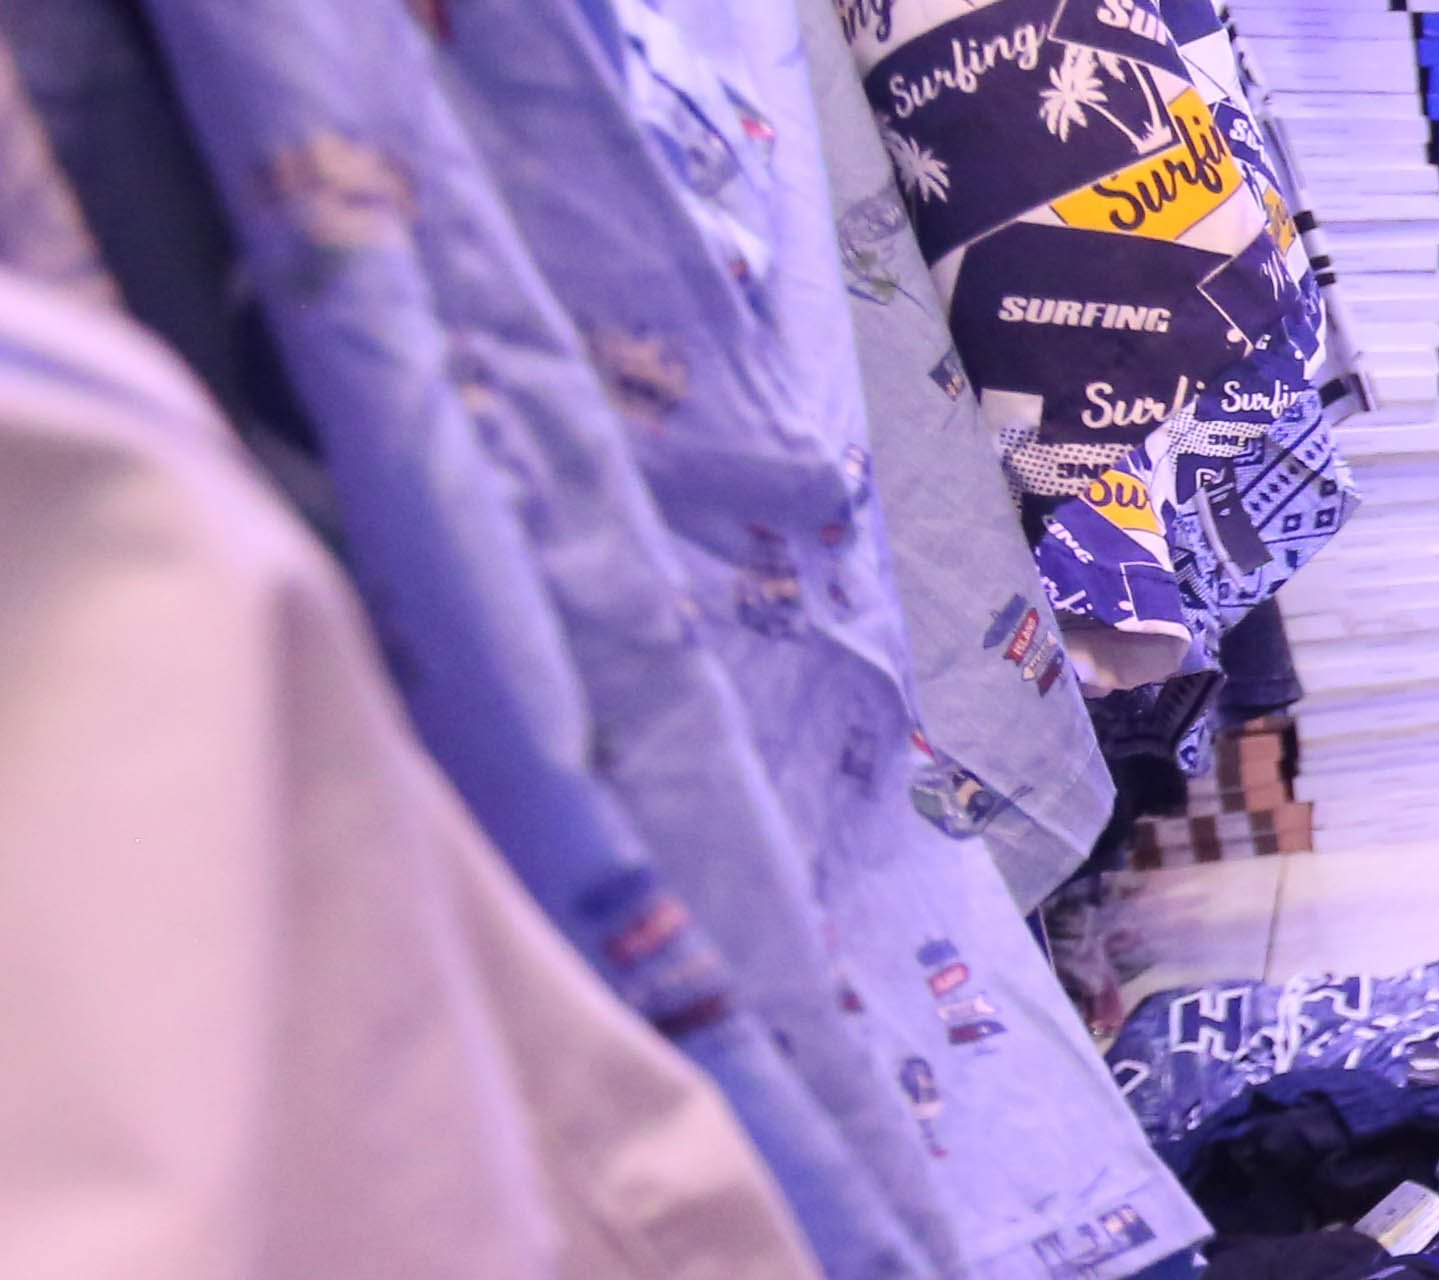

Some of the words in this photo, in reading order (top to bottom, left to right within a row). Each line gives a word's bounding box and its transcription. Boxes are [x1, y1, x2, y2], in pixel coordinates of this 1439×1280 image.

[888, 19, 1047, 116] Surfing
[1093, 114, 1227, 232] Surfi
[998, 295, 1172, 334] SURFING
[1221, 379, 1303, 420] Surfin
